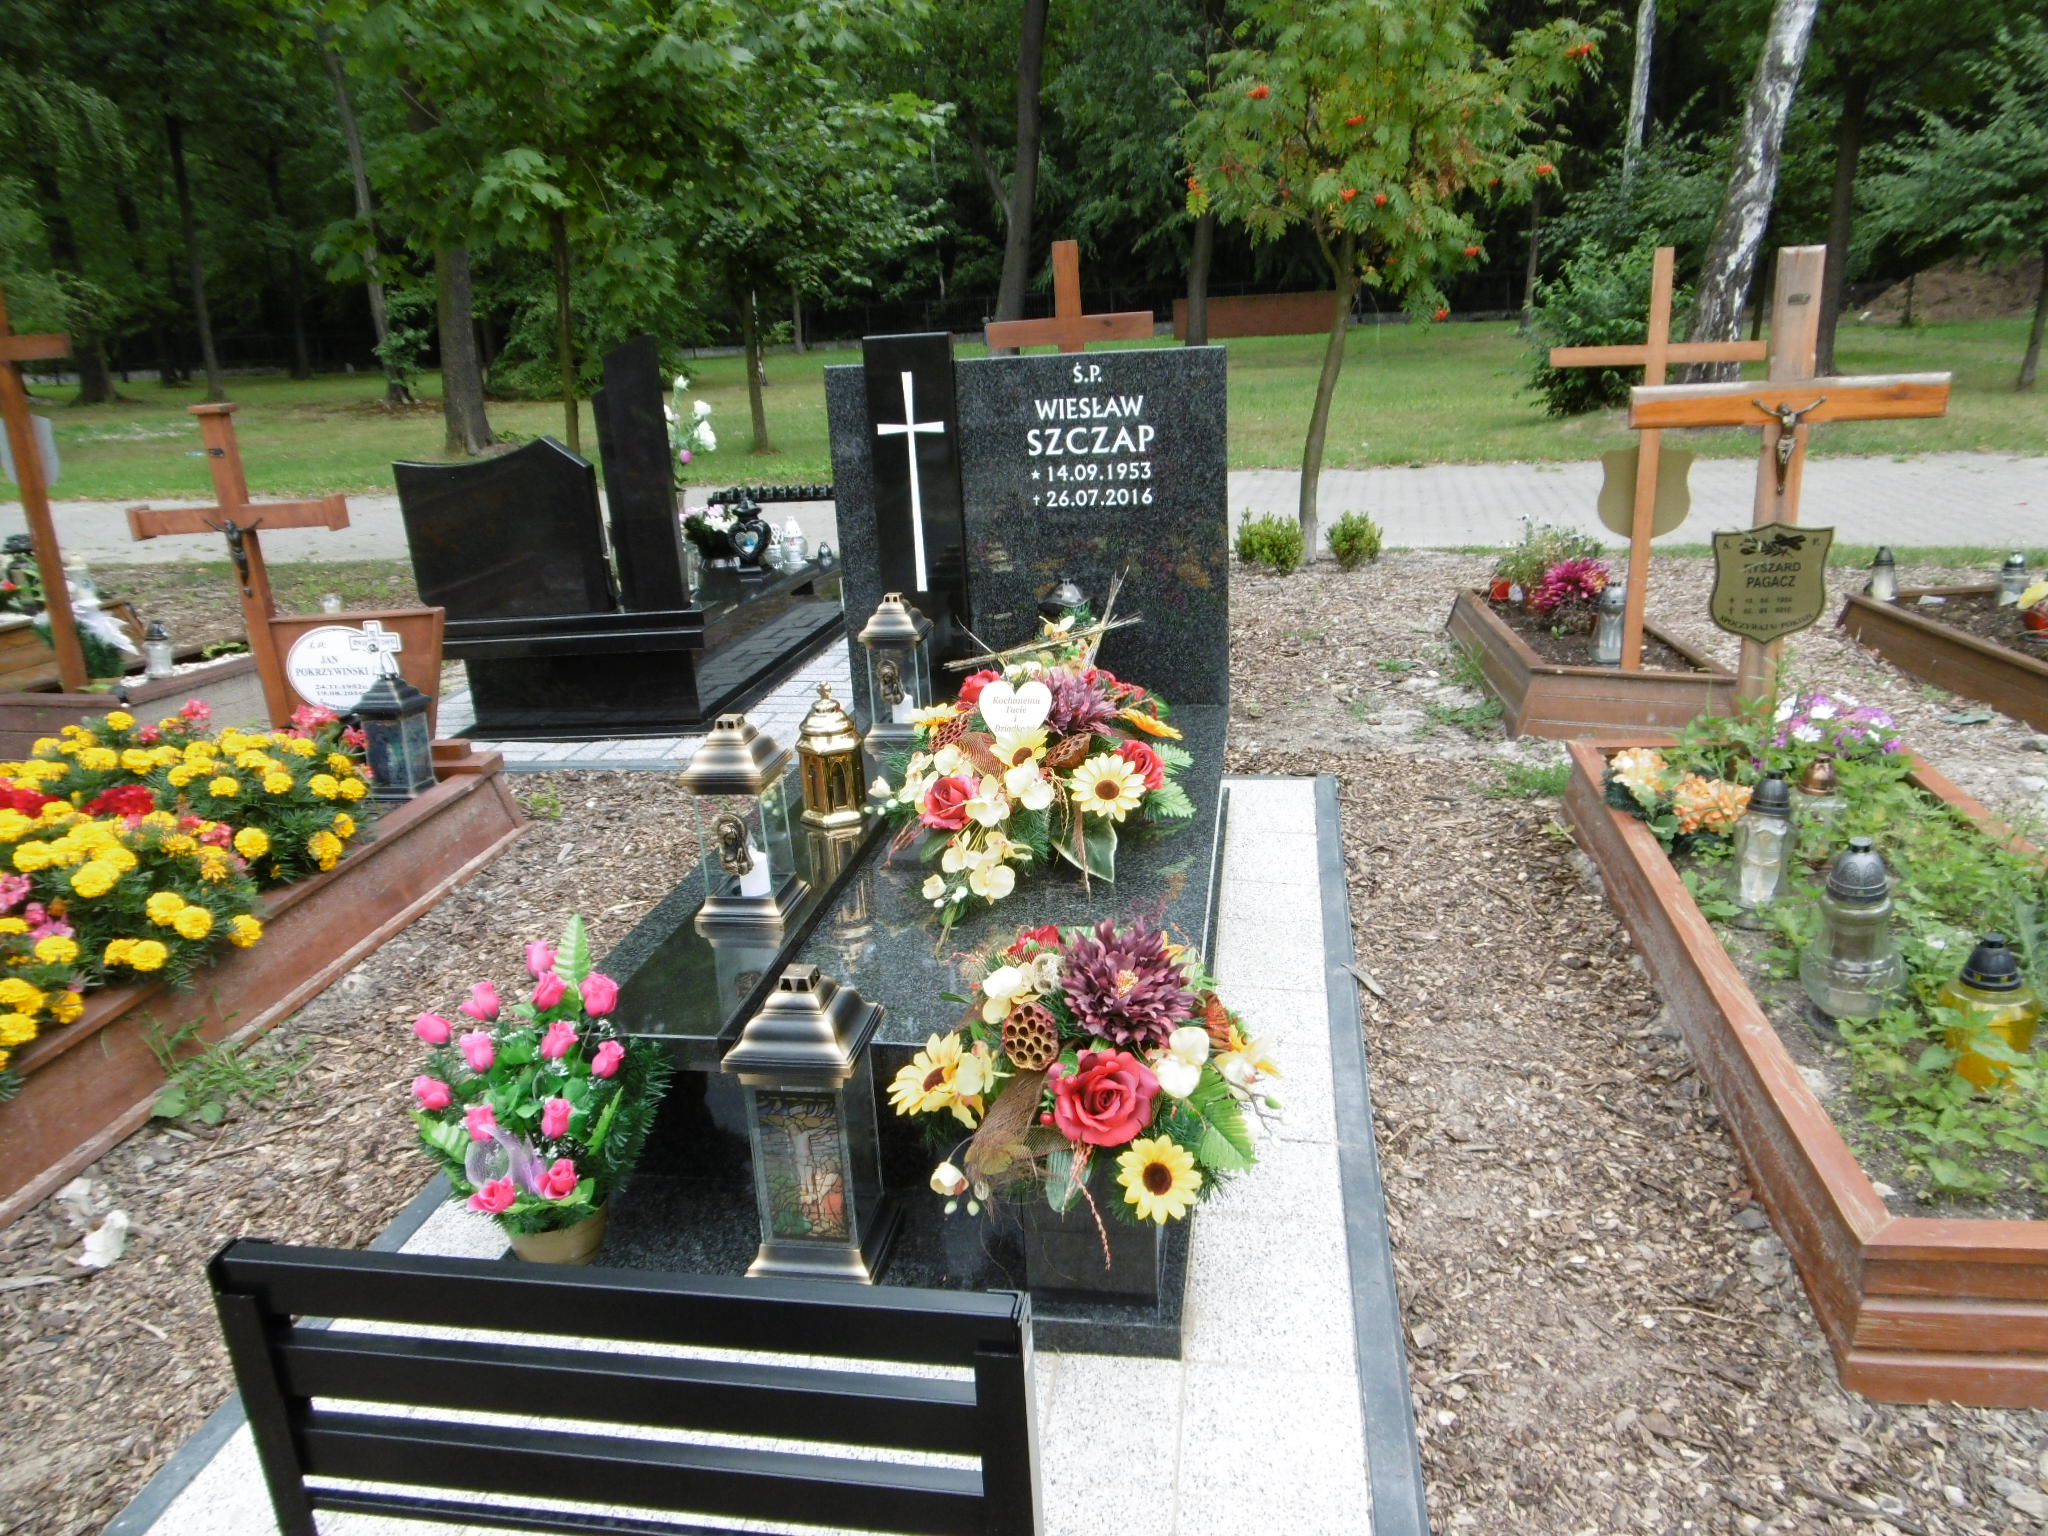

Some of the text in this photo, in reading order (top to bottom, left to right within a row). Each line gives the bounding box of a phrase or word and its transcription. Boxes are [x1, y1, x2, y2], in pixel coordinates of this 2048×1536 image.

[1034, 395, 1144, 420] WIESŁAW
[1027, 425, 1155, 456] SZCZAP
[1047, 462, 1151, 481] 14.09.1953
[1046, 488, 1153, 507] 26.07.2016
[1744, 562, 1801, 574] RYSZARD
[1746, 576, 1796, 588] PAGACZ
